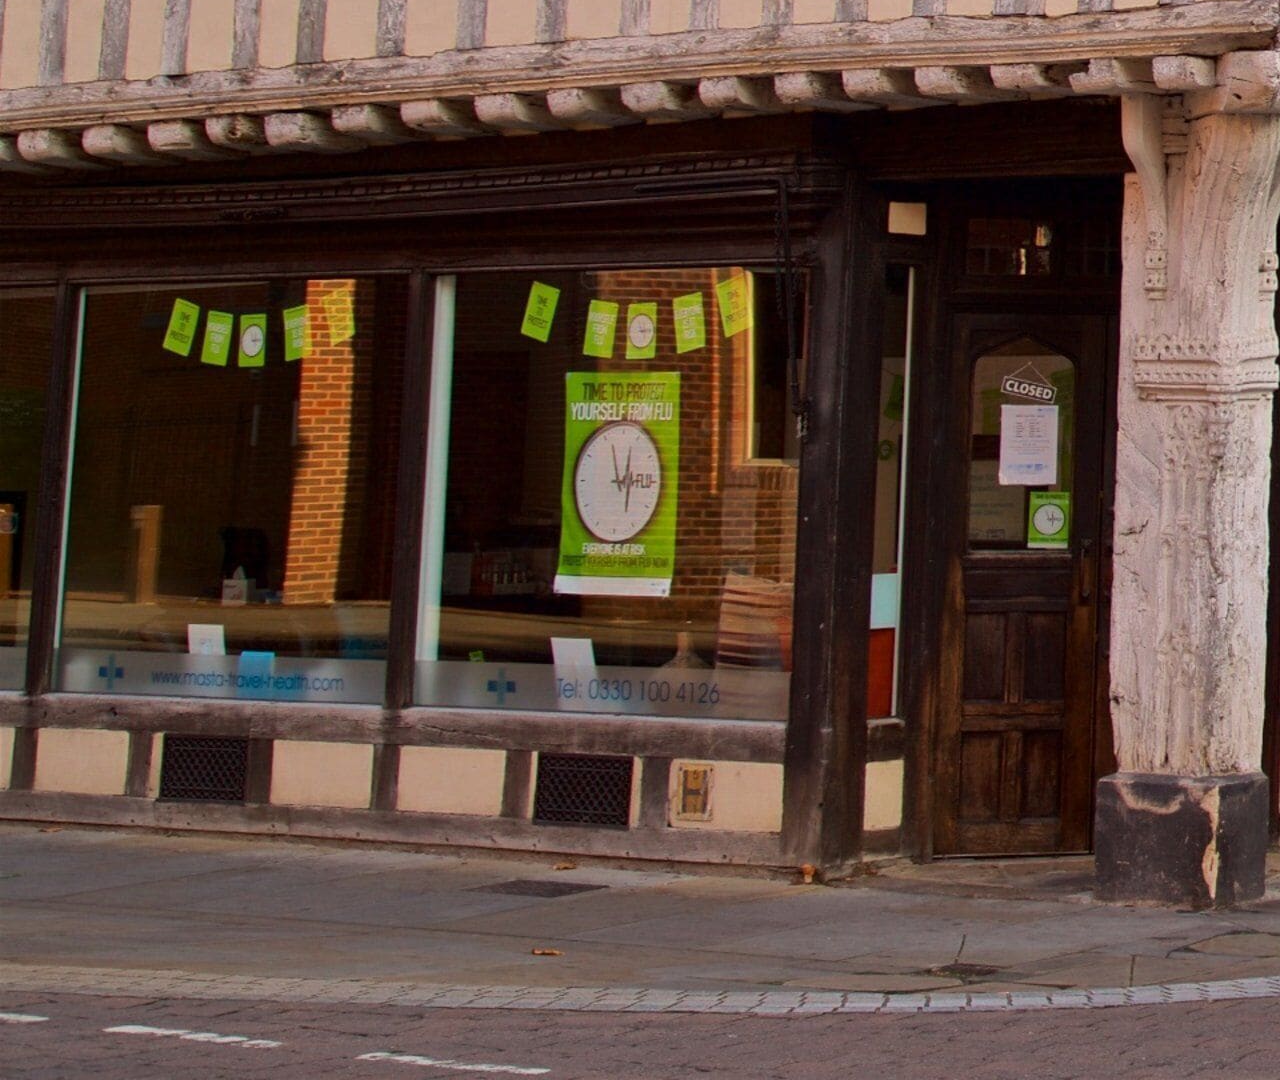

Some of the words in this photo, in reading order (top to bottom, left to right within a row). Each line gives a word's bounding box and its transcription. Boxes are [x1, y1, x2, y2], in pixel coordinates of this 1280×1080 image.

[582, 382, 607, 401] TIME
[610, 382, 624, 401] TO
[626, 382, 666, 401] PROTECT
[1005, 380, 1053, 400] CLOSED
[571, 402, 626, 421] YOURSELF
[627, 402, 653, 421] FROM
[654, 402, 673, 421] FLU
[636, 473, 653, 489] FLU
[152, 669, 345, 692] www.masta-travel-health.com
[555, 678, 582, 699] Tel:
[588, 678, 632, 701] 0330
[639, 680, 671, 703] 100
[676, 681, 720, 704] 4126
